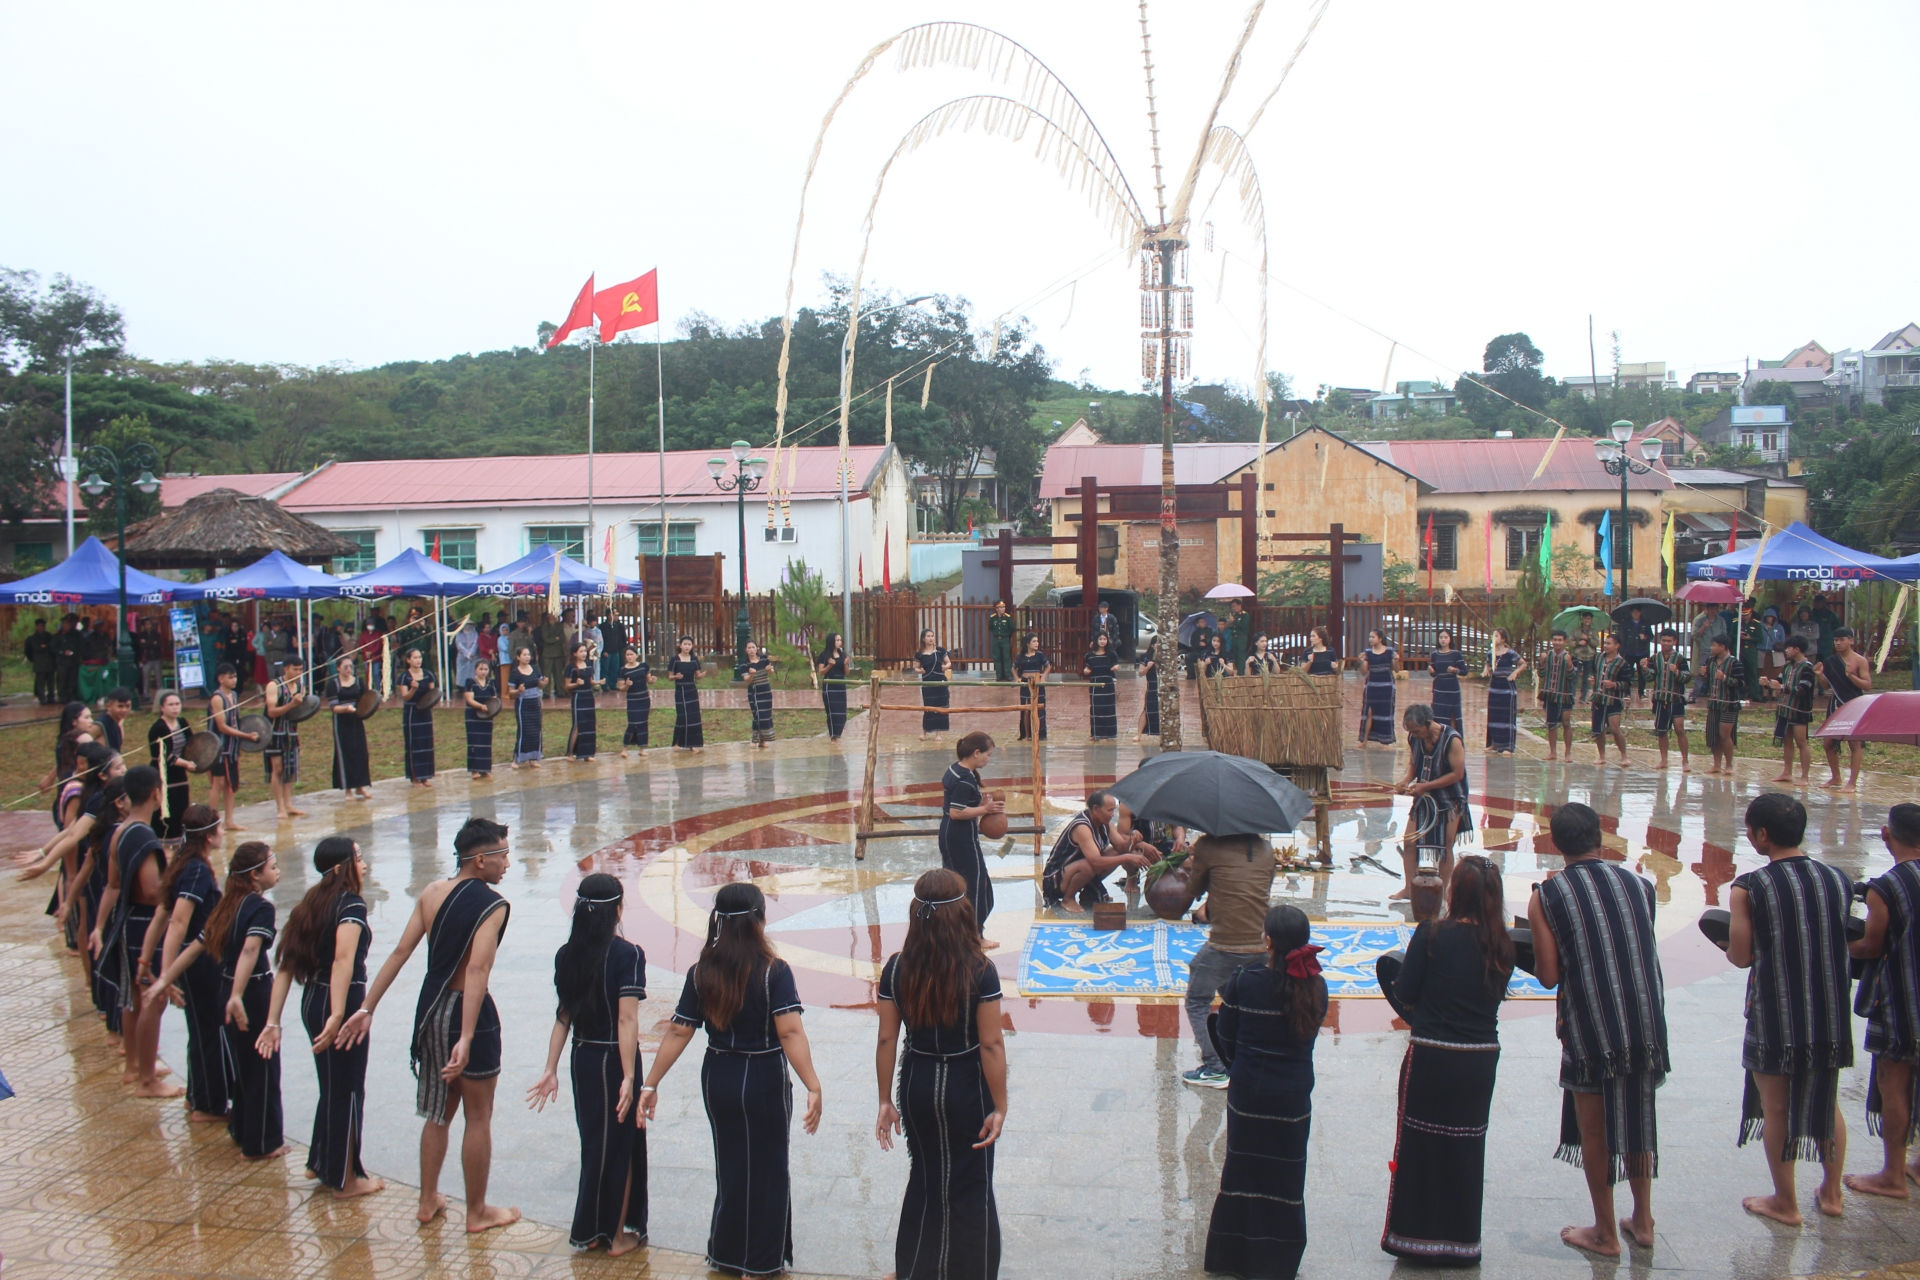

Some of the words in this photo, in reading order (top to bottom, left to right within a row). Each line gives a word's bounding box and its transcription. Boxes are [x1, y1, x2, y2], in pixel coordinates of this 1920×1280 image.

[1787, 565, 1875, 579] mobifone
[204, 587, 266, 598] mobifone
[340, 585, 403, 595] mobifone
[477, 582, 545, 594] mobifone
[15, 590, 82, 603] mobifone
